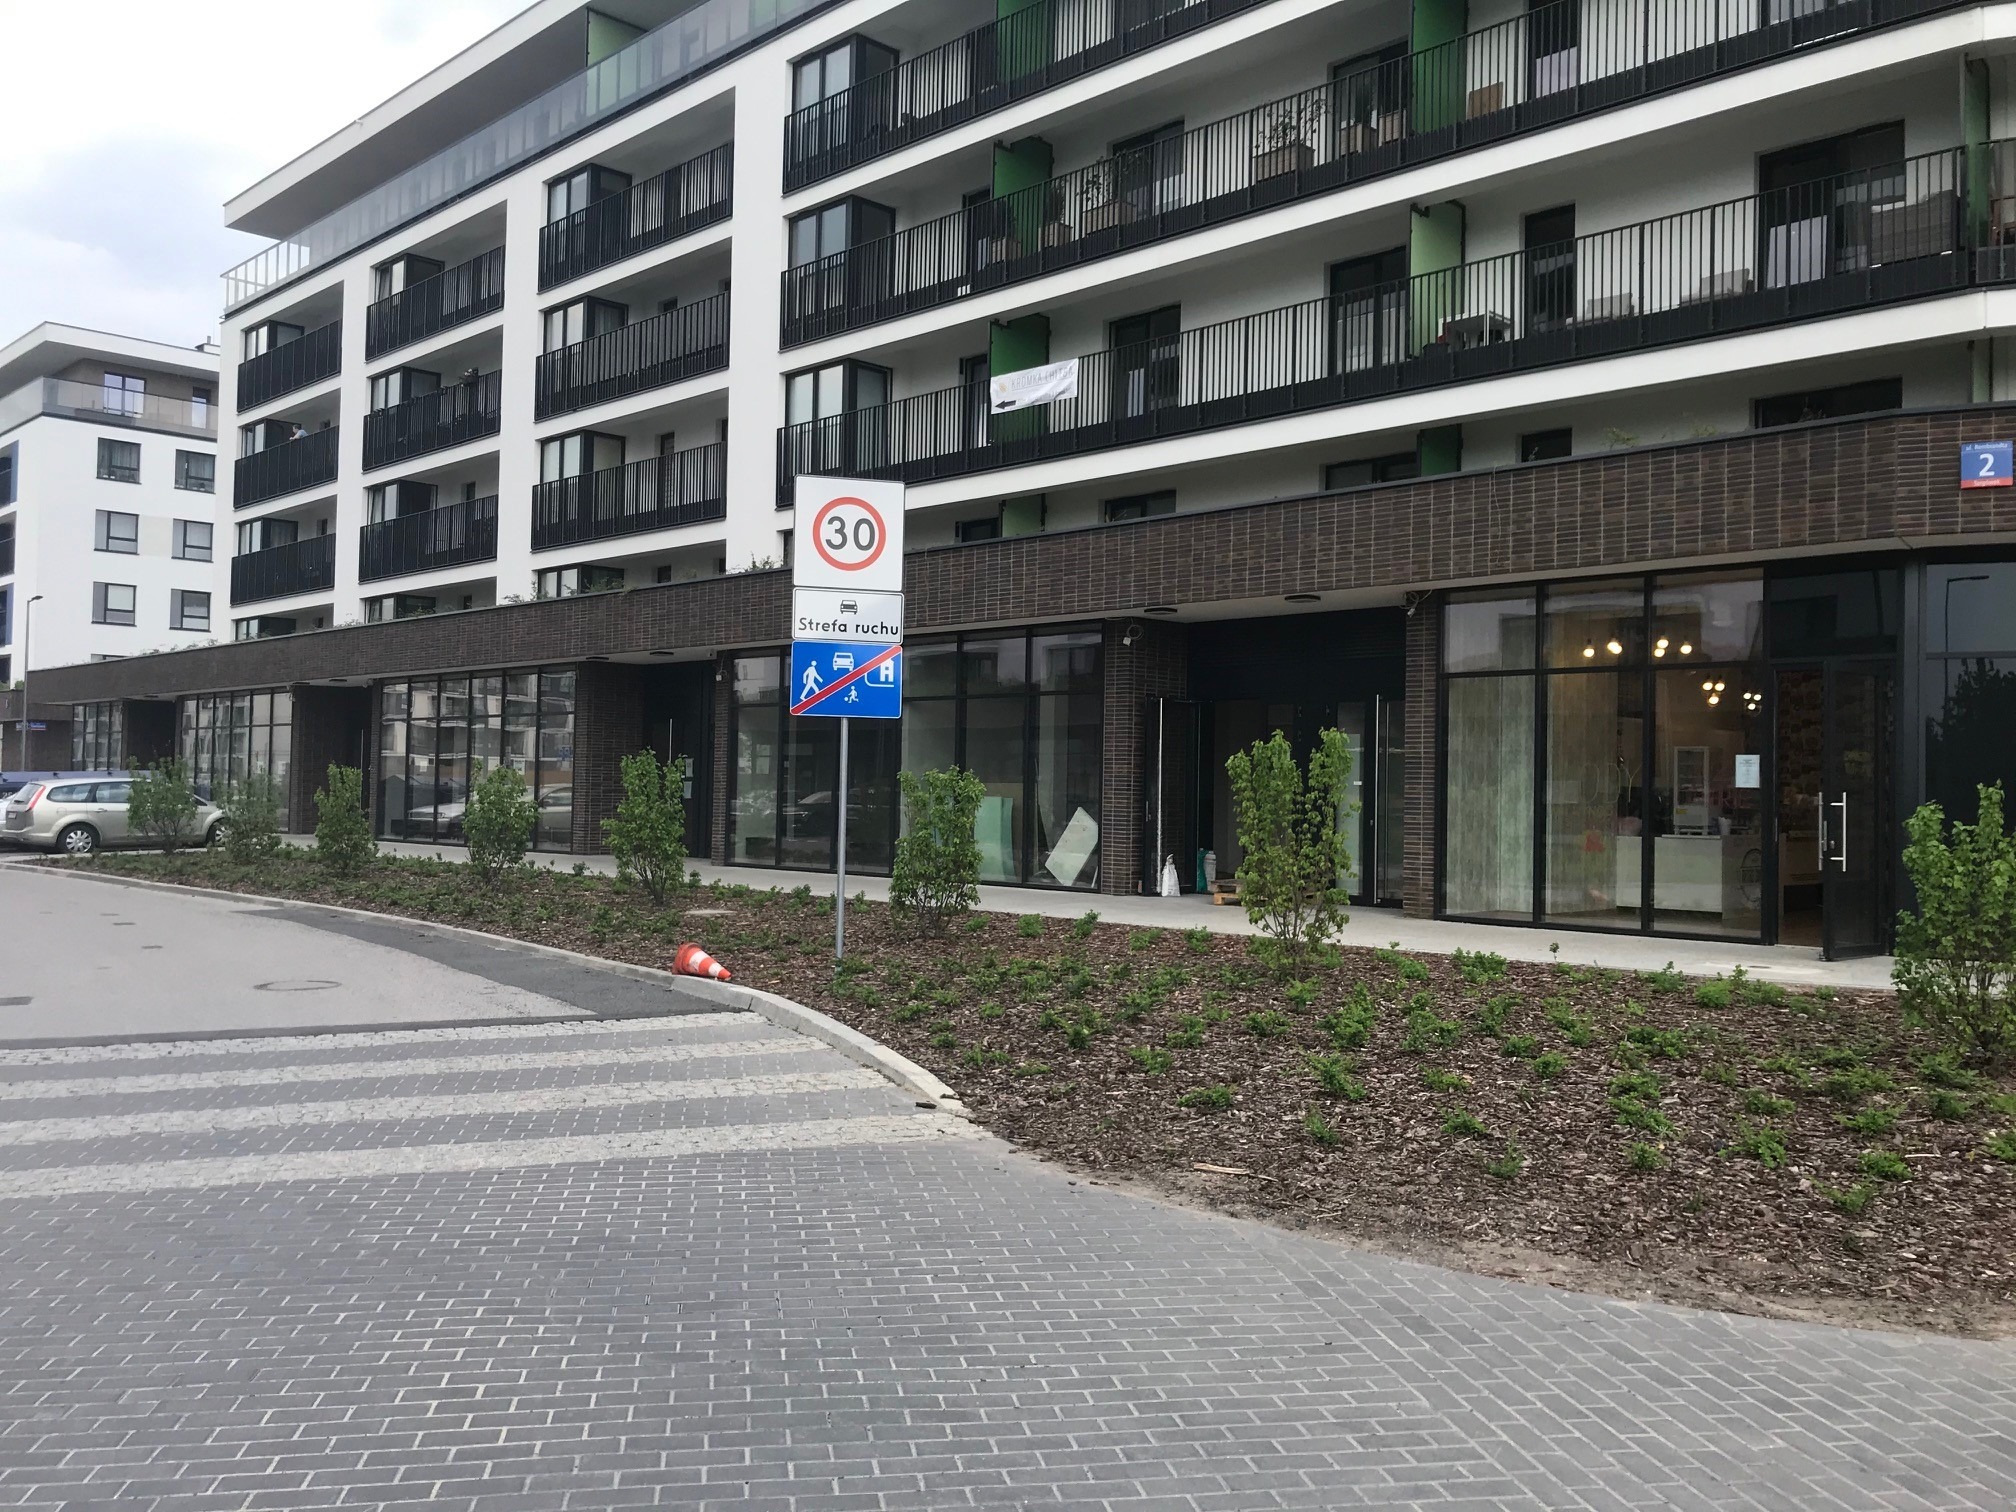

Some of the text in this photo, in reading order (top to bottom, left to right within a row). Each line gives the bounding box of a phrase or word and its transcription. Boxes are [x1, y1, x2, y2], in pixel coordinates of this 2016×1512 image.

[1011, 372, 1042, 389] KROMKA
[1979, 453, 1995, 477] 2
[825, 516, 876, 551] 30
[799, 617, 899, 636] Strefa ruchu
